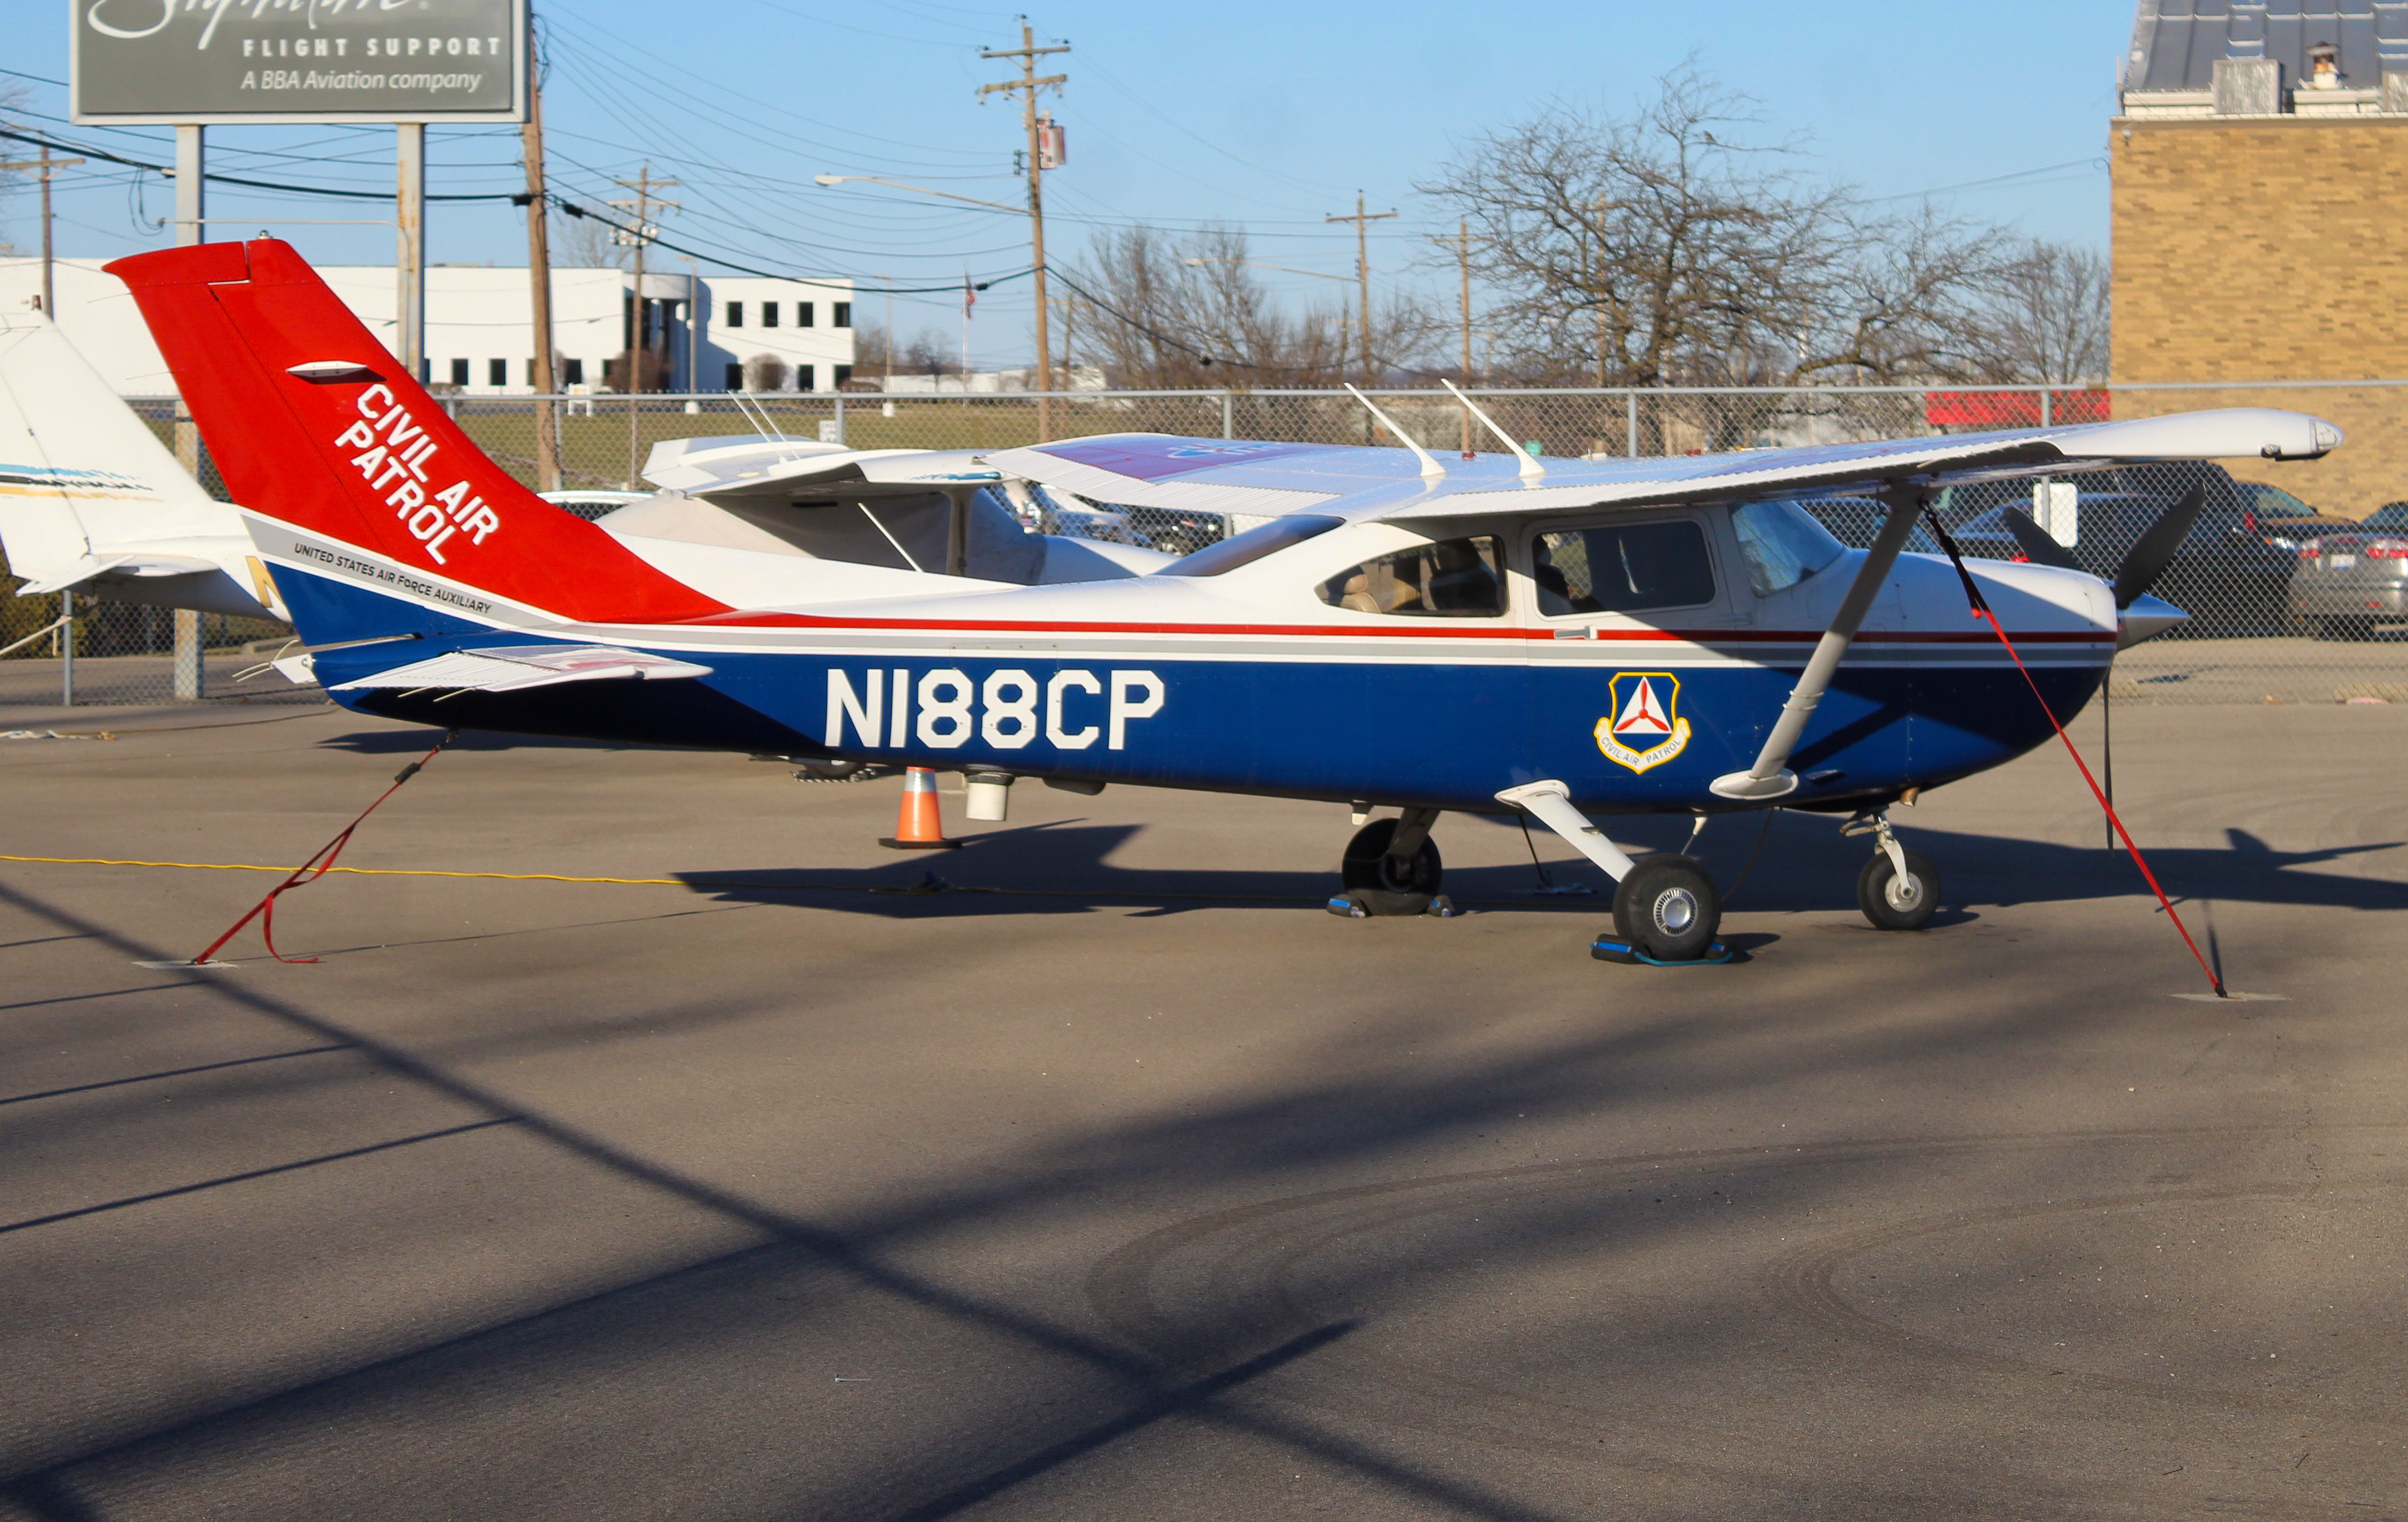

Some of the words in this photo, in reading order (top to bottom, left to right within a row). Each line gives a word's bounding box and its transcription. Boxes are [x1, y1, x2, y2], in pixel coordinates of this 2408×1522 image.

[240, 70, 257, 89] A
[261, 70, 300, 89] BBA
[303, 70, 385, 89] Aviation
[388, 72, 482, 94] company
[243, 38, 348, 57] FLIGHT
[366, 37, 500, 56] SUPPORT
[334, 420, 457, 566] PATROL
[357, 383, 438, 483] CIVIL
[434, 480, 500, 546] AIR
[294, 543, 334, 563] UNITED
[336, 556, 375, 577] STATES
[376, 569, 396, 584] AIR
[397, 575, 433, 596] FORCE
[434, 589, 491, 614] AUXILIARY
[825, 668, 1165, 750] N188CP
[1601, 737, 1621, 759] CIVIL
[1623, 753, 1639, 766] AIR
[1645, 739, 1681, 763] PATROL
